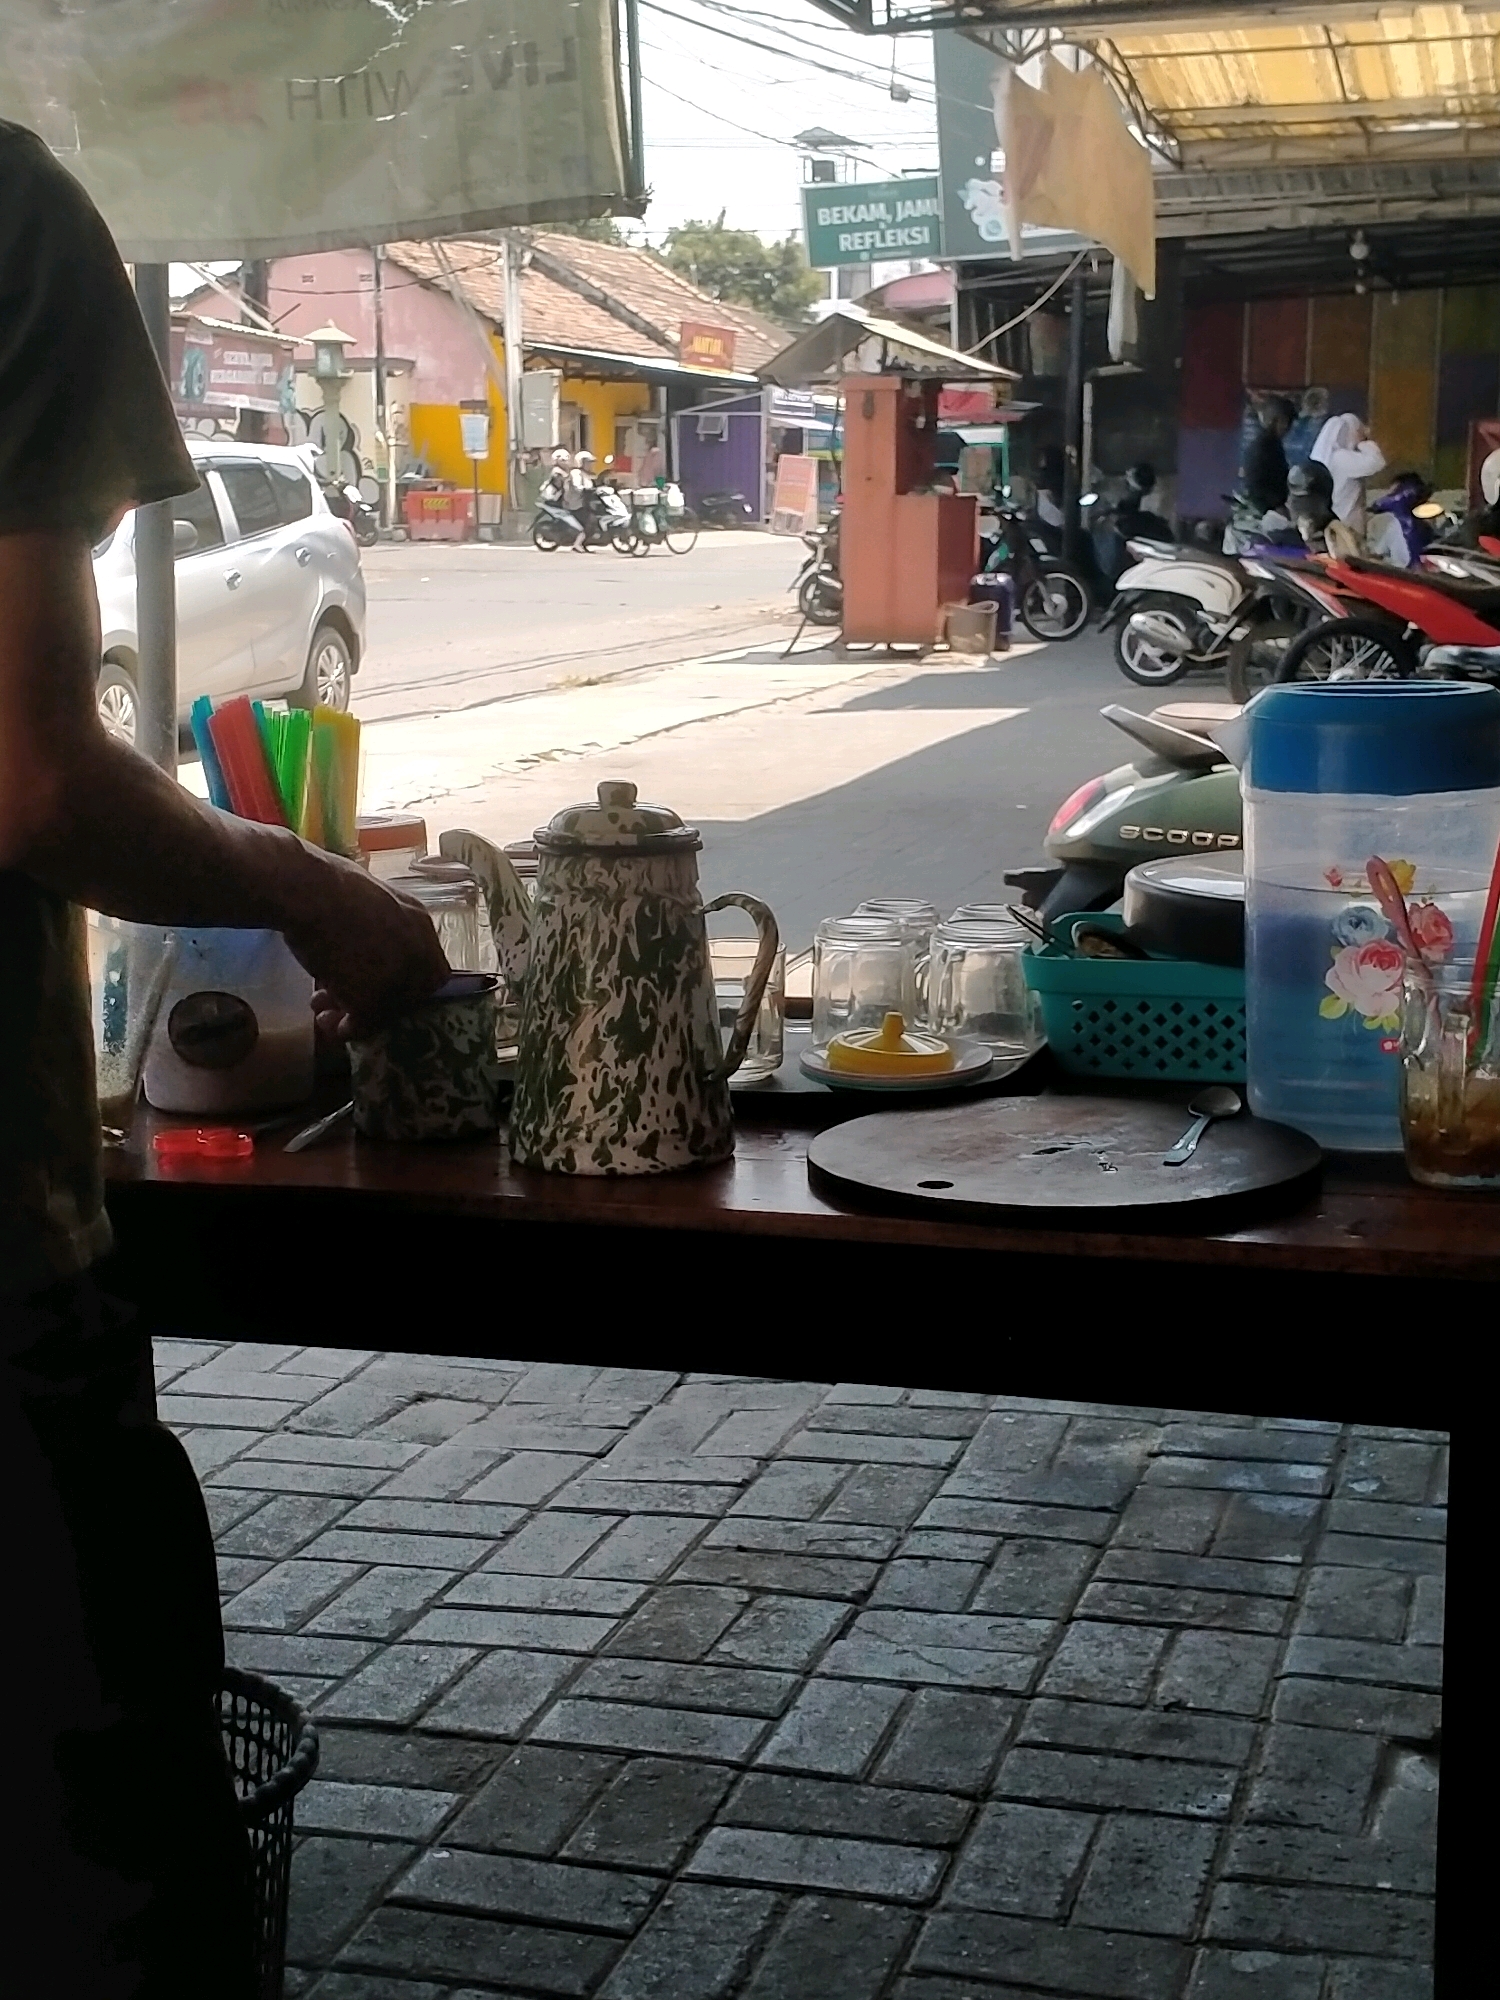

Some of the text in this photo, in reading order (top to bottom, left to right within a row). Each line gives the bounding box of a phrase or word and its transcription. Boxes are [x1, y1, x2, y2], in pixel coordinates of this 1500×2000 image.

[817, 202, 893, 226] BEKAM,
[838, 226, 930, 252] REFLEKSI
[1119, 825, 1240, 848] SCOOP
